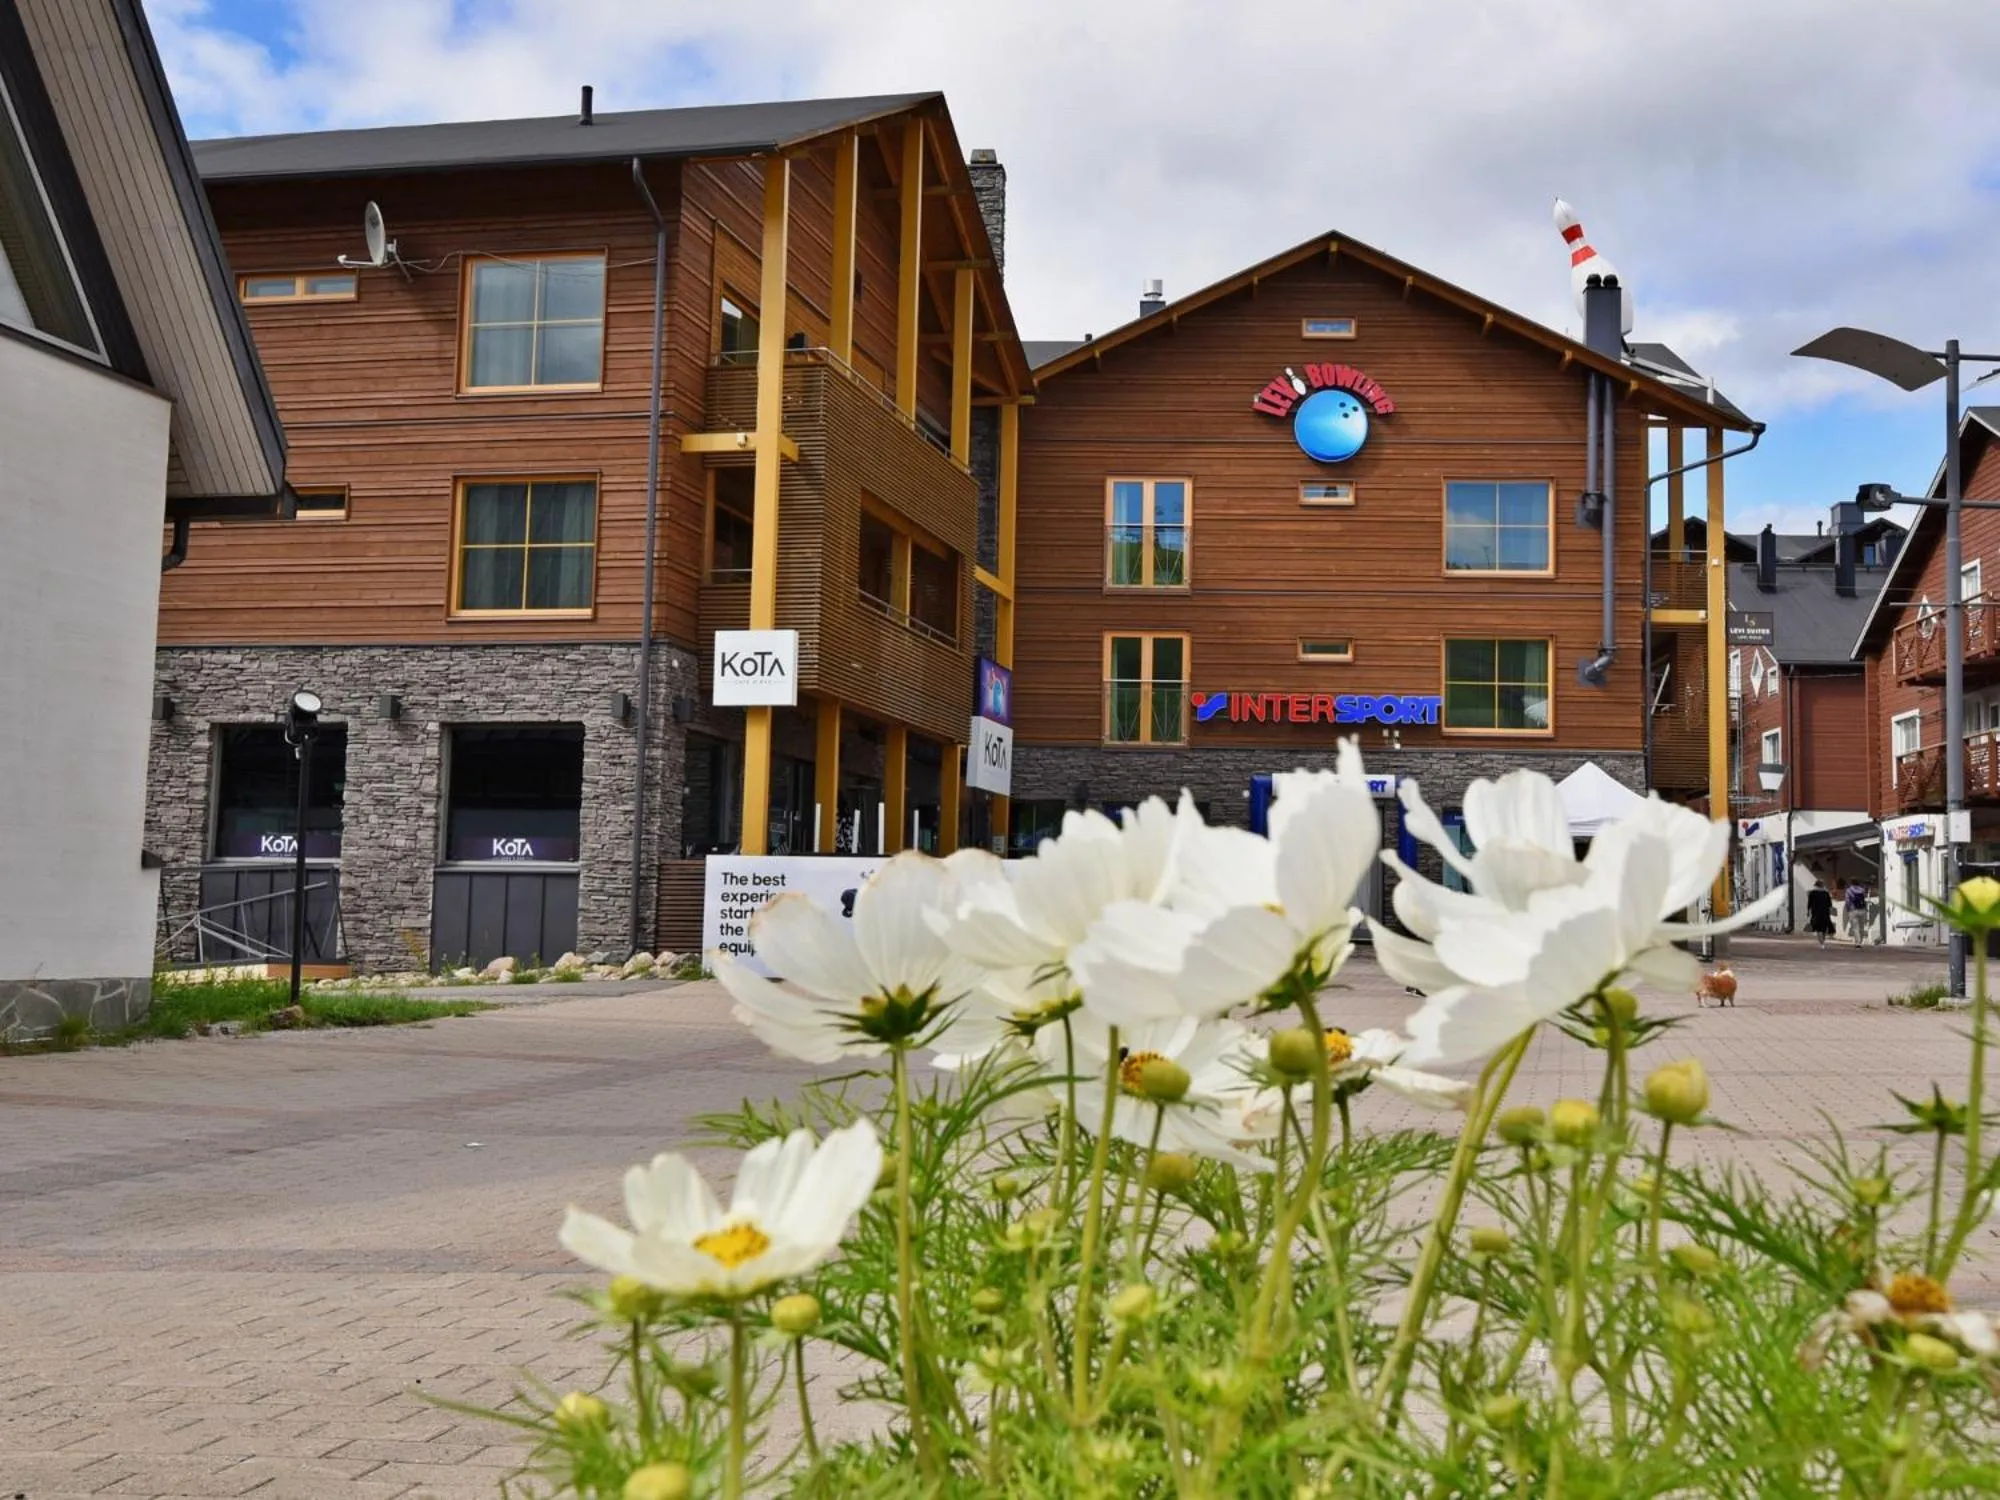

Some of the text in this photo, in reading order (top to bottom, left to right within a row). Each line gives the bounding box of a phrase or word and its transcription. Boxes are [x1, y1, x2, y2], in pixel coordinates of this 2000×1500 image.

[1304, 362, 1397, 416] BOWLING
[1231, 692, 1444, 724] INTERSPORT
[721, 872, 786, 886] The best
[719, 923, 744, 936] the
